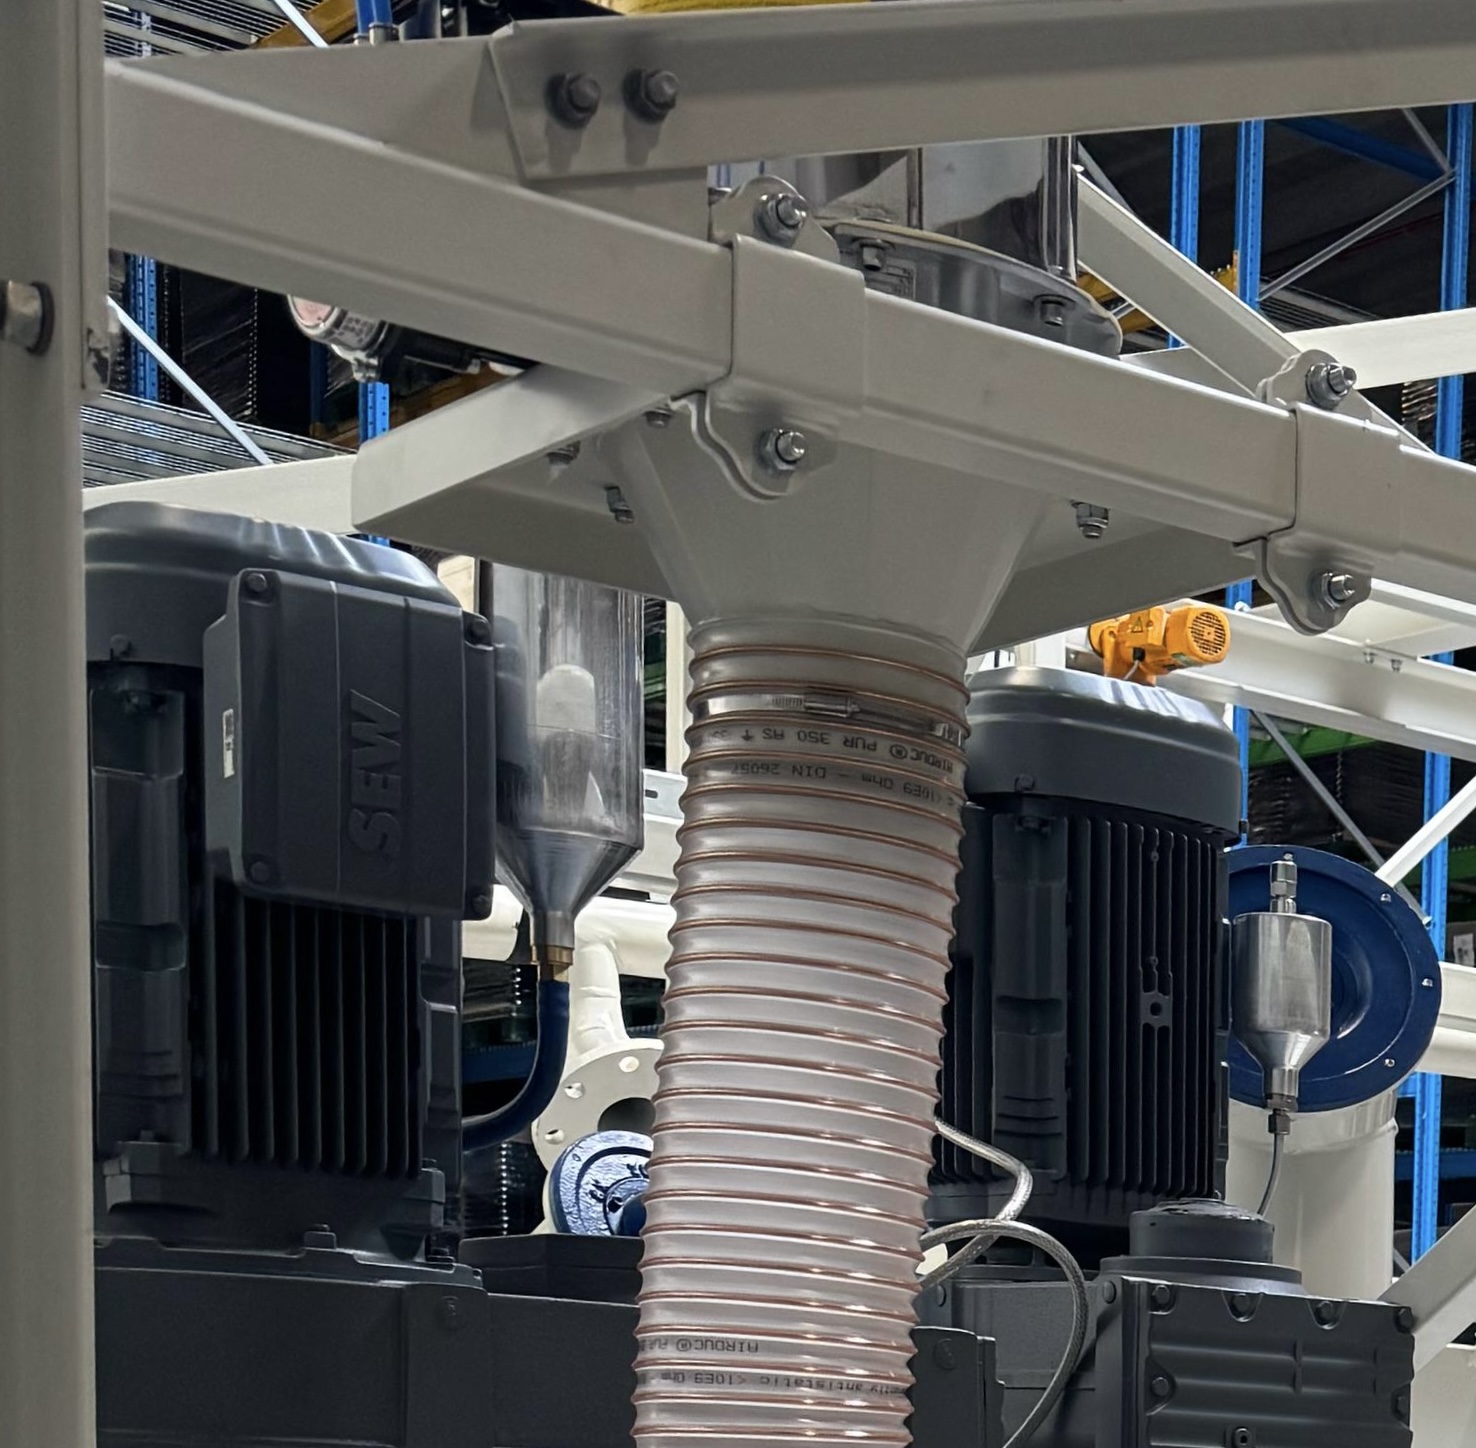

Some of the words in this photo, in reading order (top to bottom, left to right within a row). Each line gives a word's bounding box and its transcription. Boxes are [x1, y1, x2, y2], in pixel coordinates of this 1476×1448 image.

[797, 729, 831, 746] 350
[843, 735, 877, 752] PUR
[347, 689, 402, 853] SEW
[791, 763, 828, 780] DIN
[759, 1376, 865, 1394] antistatic
